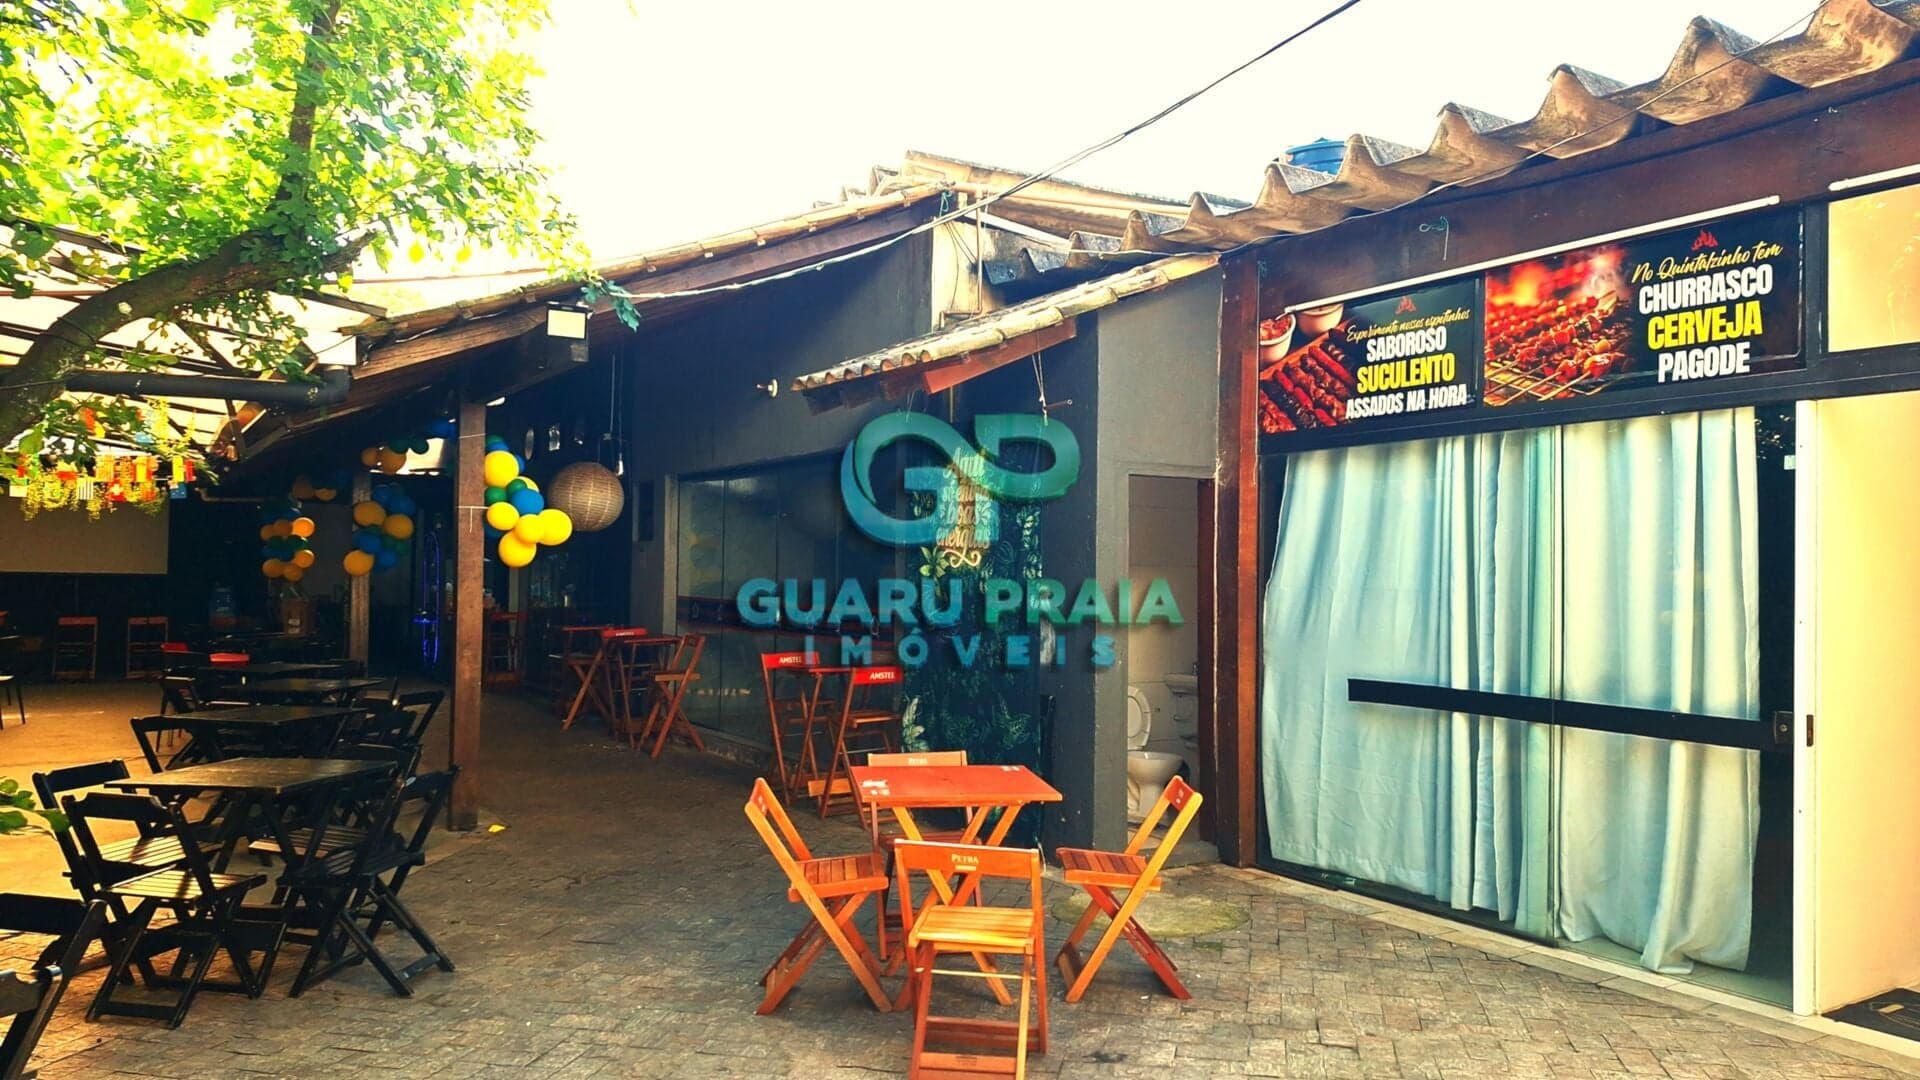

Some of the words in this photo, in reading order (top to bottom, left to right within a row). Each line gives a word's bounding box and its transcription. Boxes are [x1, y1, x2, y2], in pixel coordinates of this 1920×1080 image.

[1631, 262, 1654, 284] No
[1638, 263, 1774, 315] CHURRASCO
[1366, 325, 1448, 363] SABOROSO
[1647, 300, 1763, 350] CERVEJA
[1356, 352, 1456, 394] SUCULENTO
[1657, 341, 1751, 384] PAGODE
[1344, 391, 1405, 420] ASSADOS
[1405, 388, 1427, 413] NA
[1427, 383, 1468, 410] HORA
[869, 671, 895, 681] AMSTEL
